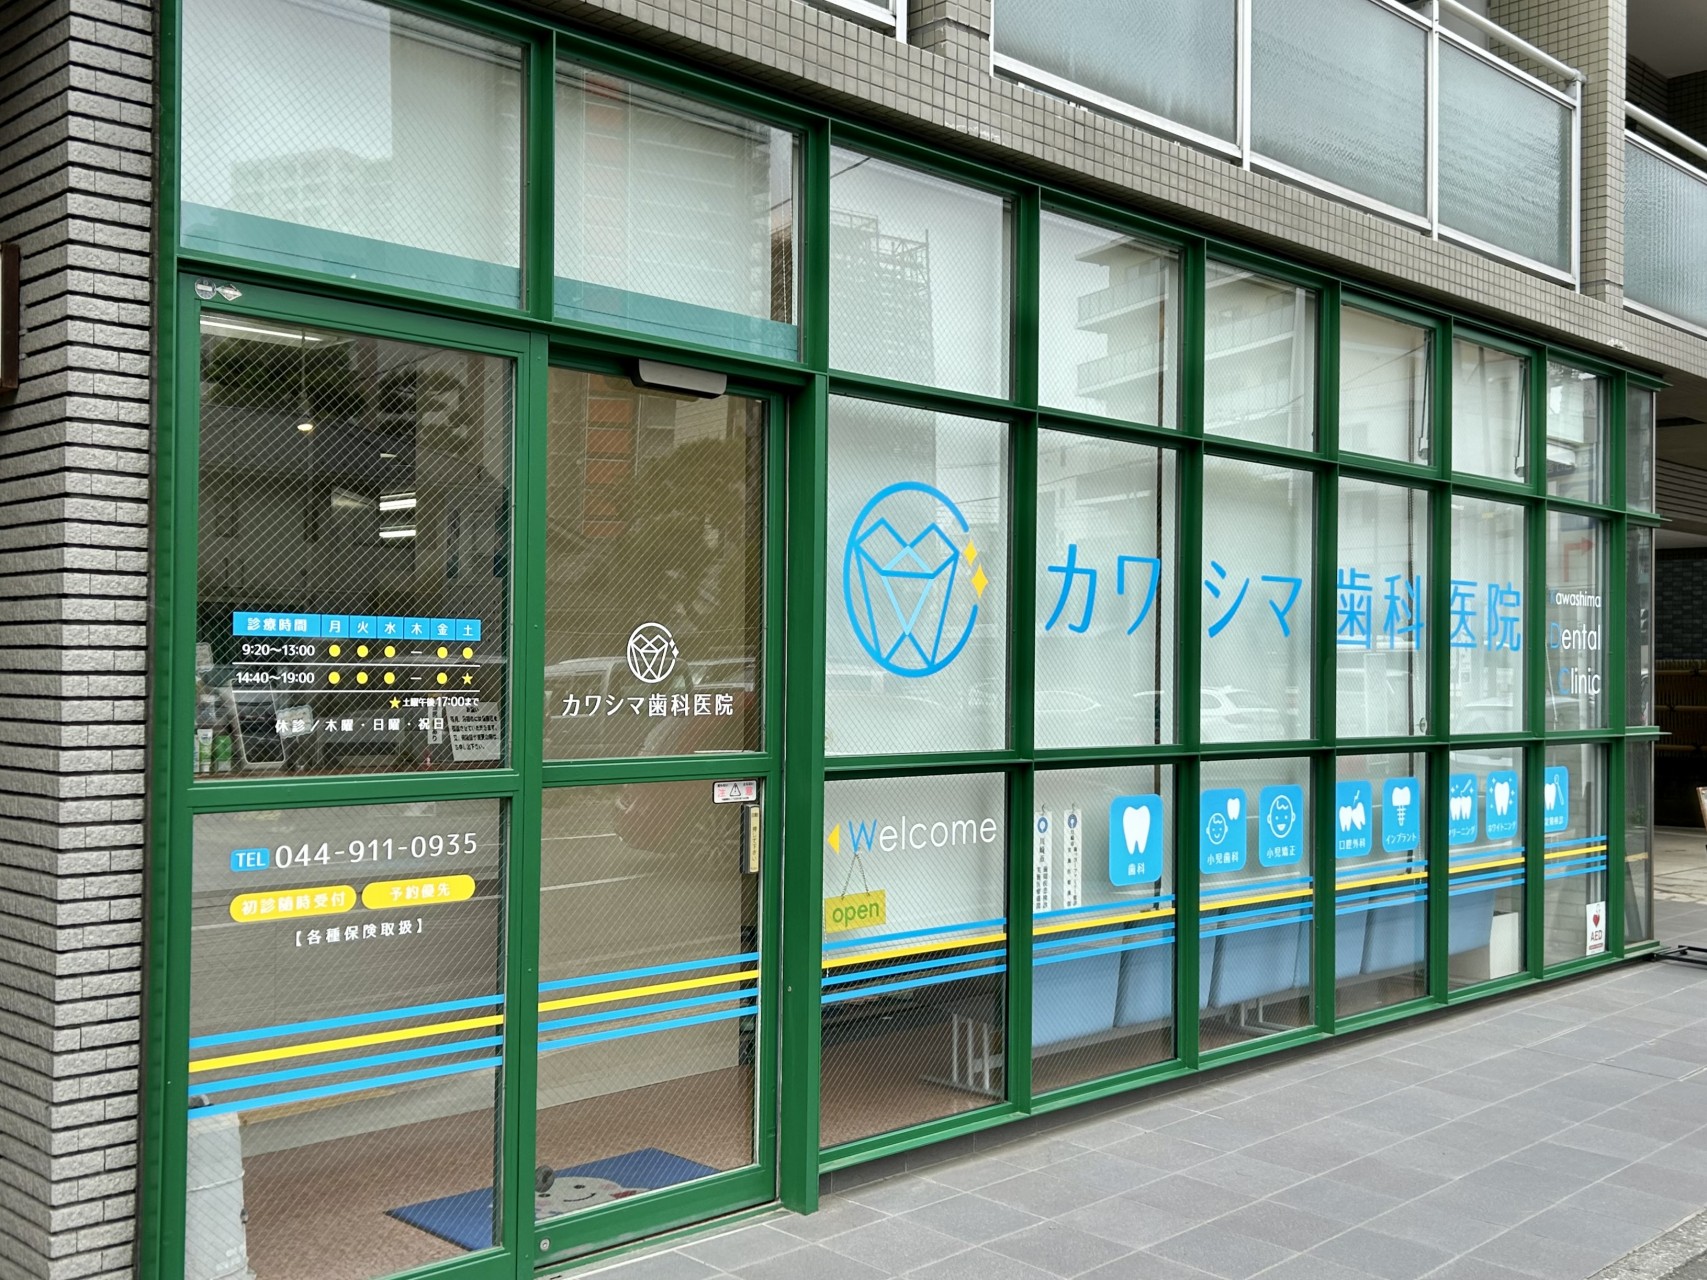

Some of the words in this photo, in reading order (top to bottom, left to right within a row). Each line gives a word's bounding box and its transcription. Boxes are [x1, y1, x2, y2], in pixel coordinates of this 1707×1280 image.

[247, 617, 308, 632] 診療時間
[329, 620, 341, 632] 月
[357, 621, 369, 634] 火
[385, 622, 397, 634] 水
[411, 623, 423, 635] 木
[437, 624, 449, 636] 金
[463, 625, 474, 636] 土
[1550, 622, 1601, 650] Dental
[1558, 667, 1602, 695] Clinic
[562, 693, 734, 717] カワシマ歯科医院
[848, 815, 997, 853] Welcome
[1339, 838, 1366, 850] 口腔外科
[1386, 832, 1417, 845] インプラント
[235, 851, 266, 868] TEL
[275, 832, 478, 869] 044-911-0935
[1206, 851, 1239, 865] 小児歯科
[1266, 845, 1296, 859] 小児矯正
[1127, 862, 1145, 876] 歯科
[241, 891, 346, 916] 初診随時受付
[389, 882, 452, 902] 予約優先
[832, 901, 880, 928] open
